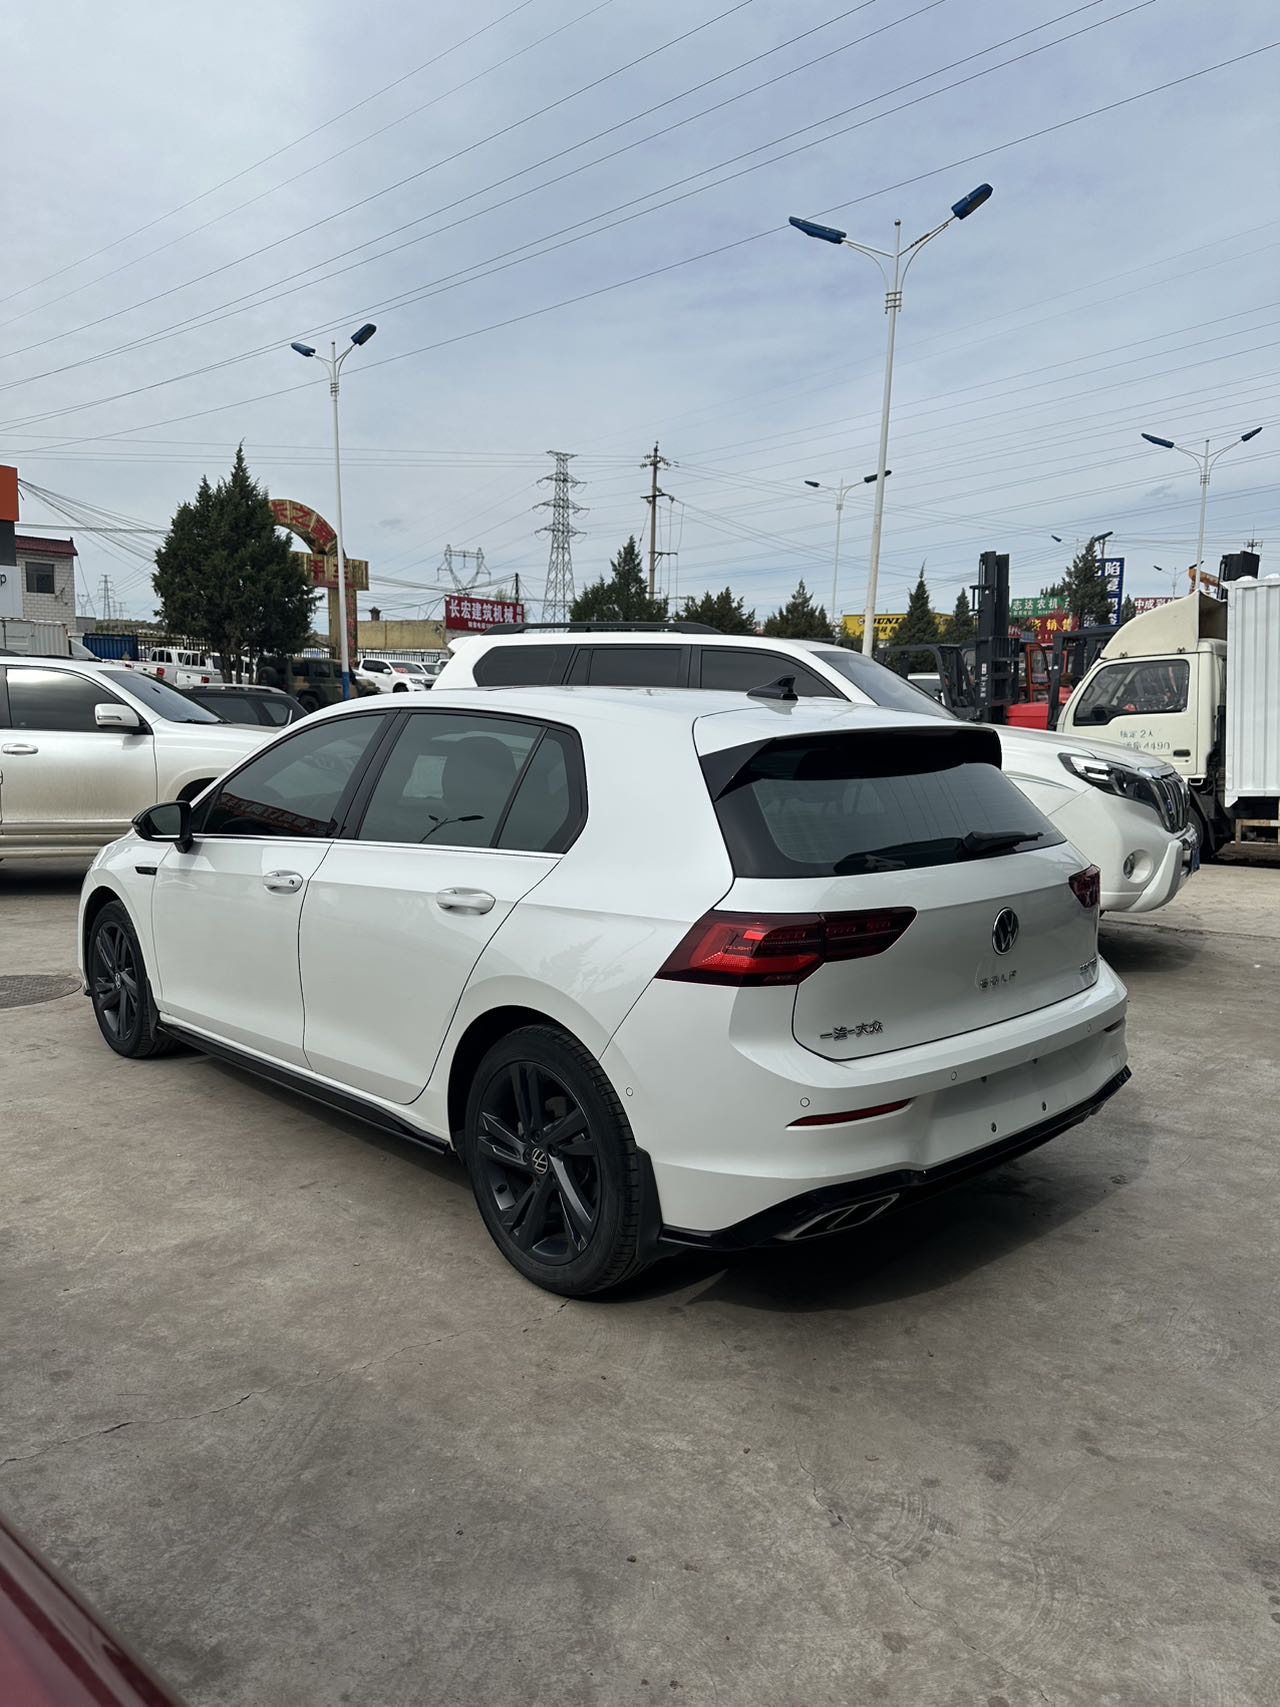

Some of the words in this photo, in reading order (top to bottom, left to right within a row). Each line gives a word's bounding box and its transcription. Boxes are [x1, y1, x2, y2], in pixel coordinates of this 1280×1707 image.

[449, 599, 514, 624] 长宏建筑机械
